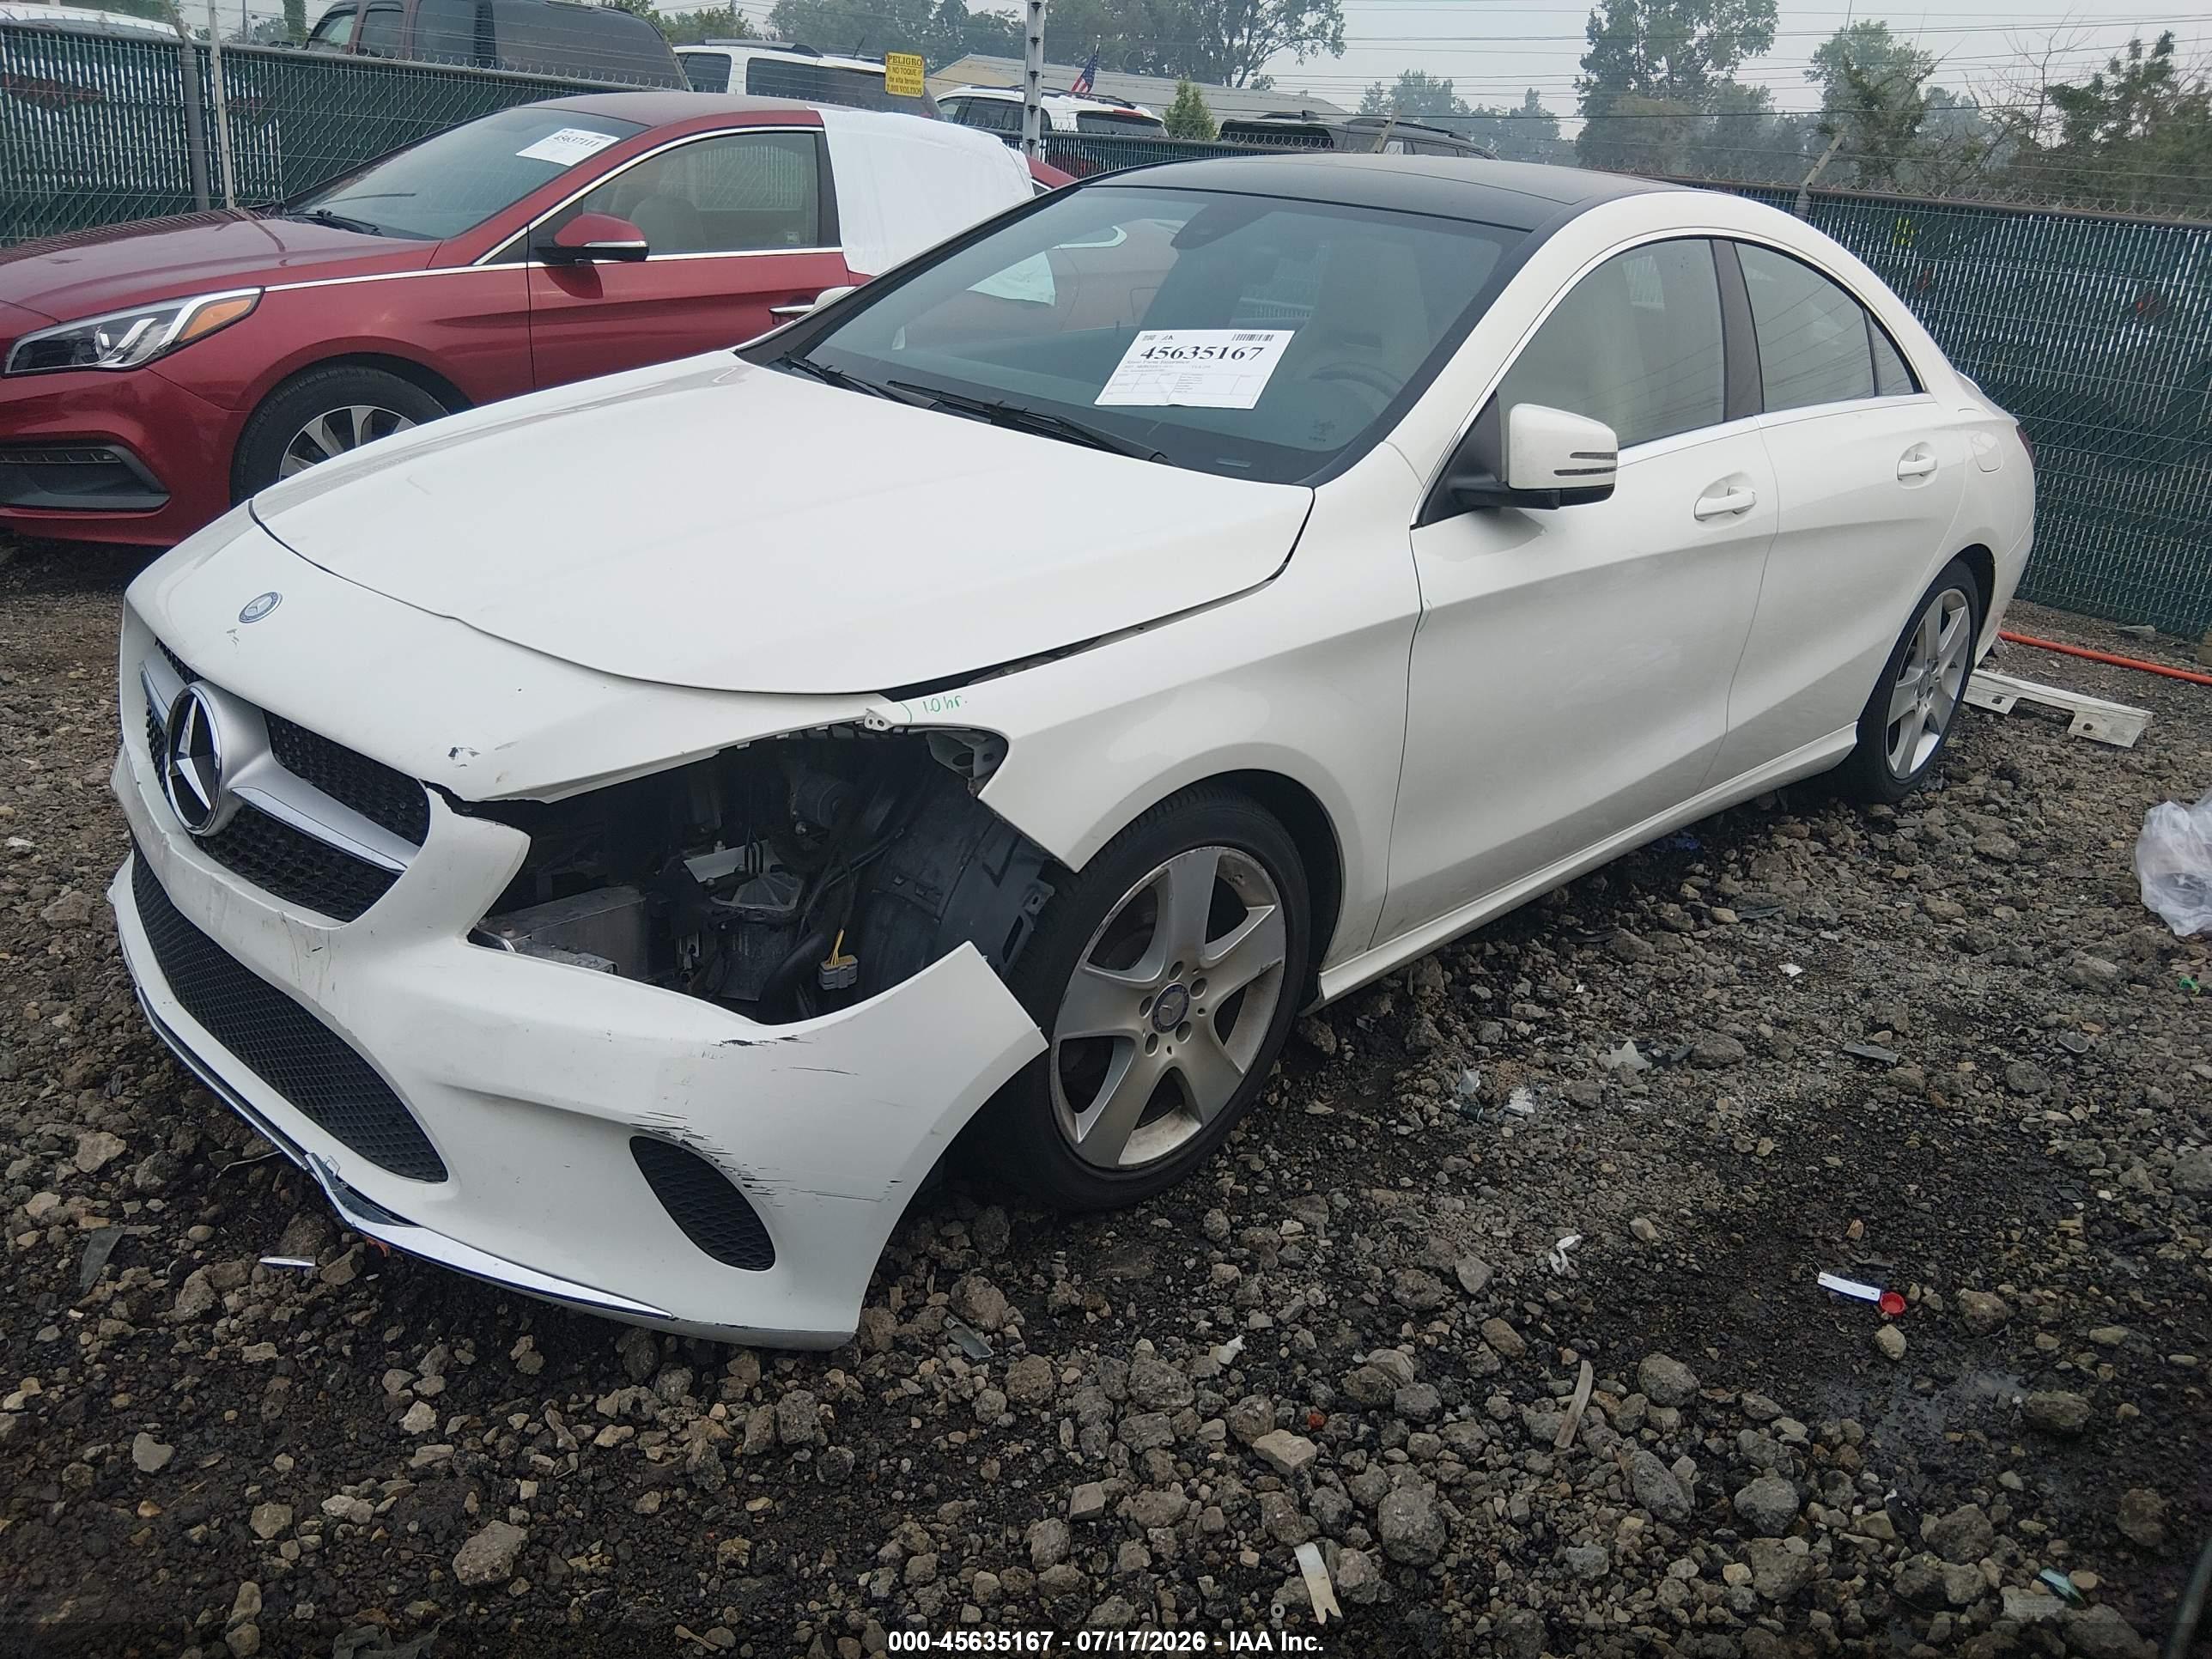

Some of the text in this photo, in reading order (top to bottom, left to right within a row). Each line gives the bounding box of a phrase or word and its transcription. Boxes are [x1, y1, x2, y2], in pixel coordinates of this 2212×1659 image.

[887, 55, 922, 67] PELIGRO
[901, 67, 917, 76] TOQUE
[1140, 345, 1265, 361] 45635167
